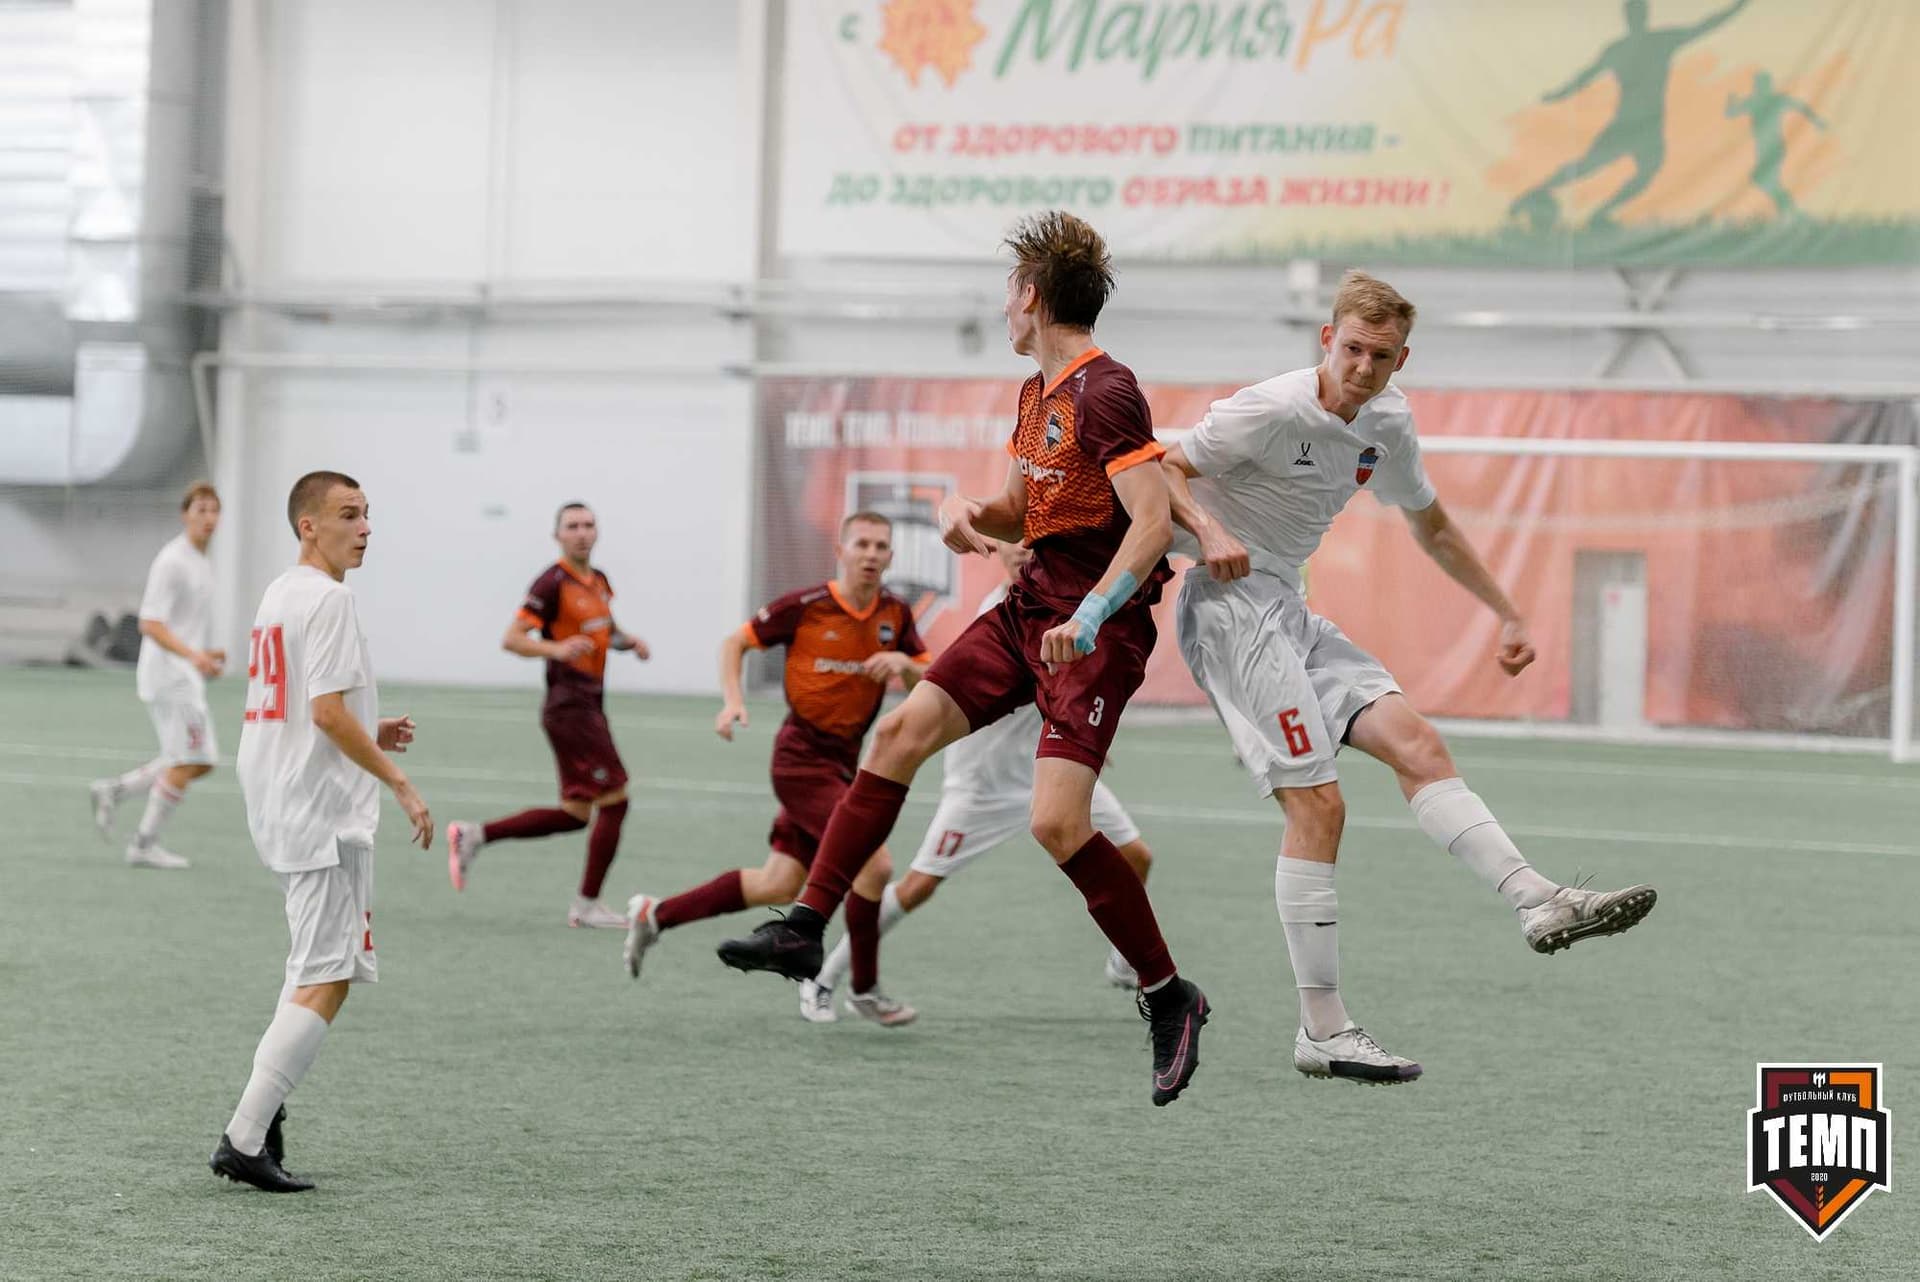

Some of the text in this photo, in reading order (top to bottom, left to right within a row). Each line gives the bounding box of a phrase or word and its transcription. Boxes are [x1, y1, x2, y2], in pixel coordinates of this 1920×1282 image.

[893, 122, 941, 152] ОТ
[951, 122, 1179, 156] ЗДОРОВОГО
[1187, 122, 1377, 153] ПИТАНИЯ
[826, 173, 880, 206] ДО
[889, 173, 1114, 206] ЗДОРОВОГО
[1121, 175, 1268, 206] ОБРАЗА
[1088, 696, 1105, 727] 3
[1277, 707, 1314, 758] 6
[936, 829, 965, 858] 17
